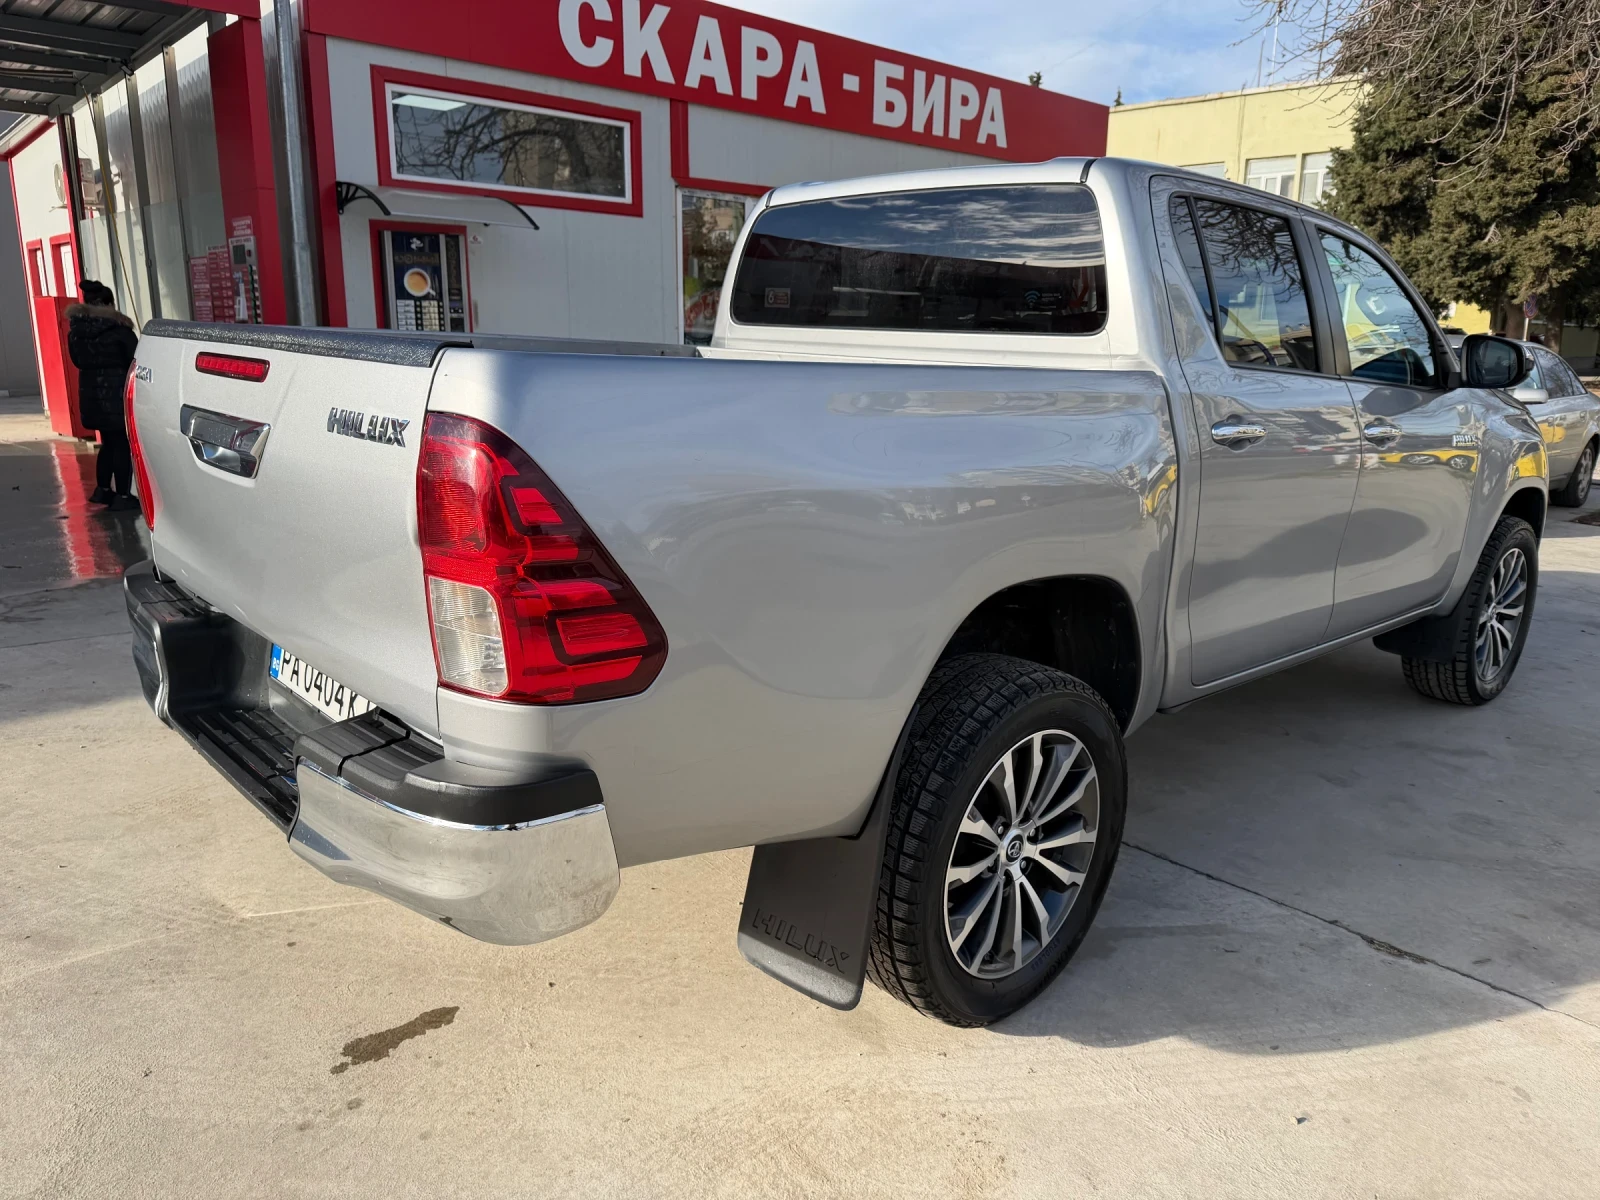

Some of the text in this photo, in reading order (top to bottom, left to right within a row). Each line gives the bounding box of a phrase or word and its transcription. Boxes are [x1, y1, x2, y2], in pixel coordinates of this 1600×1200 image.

[558, 0, 827, 115] СКАРА
[873, 59, 1008, 148] БИРА
[327, 406, 411, 448] HILUX
[752, 908, 850, 974] HILUX
